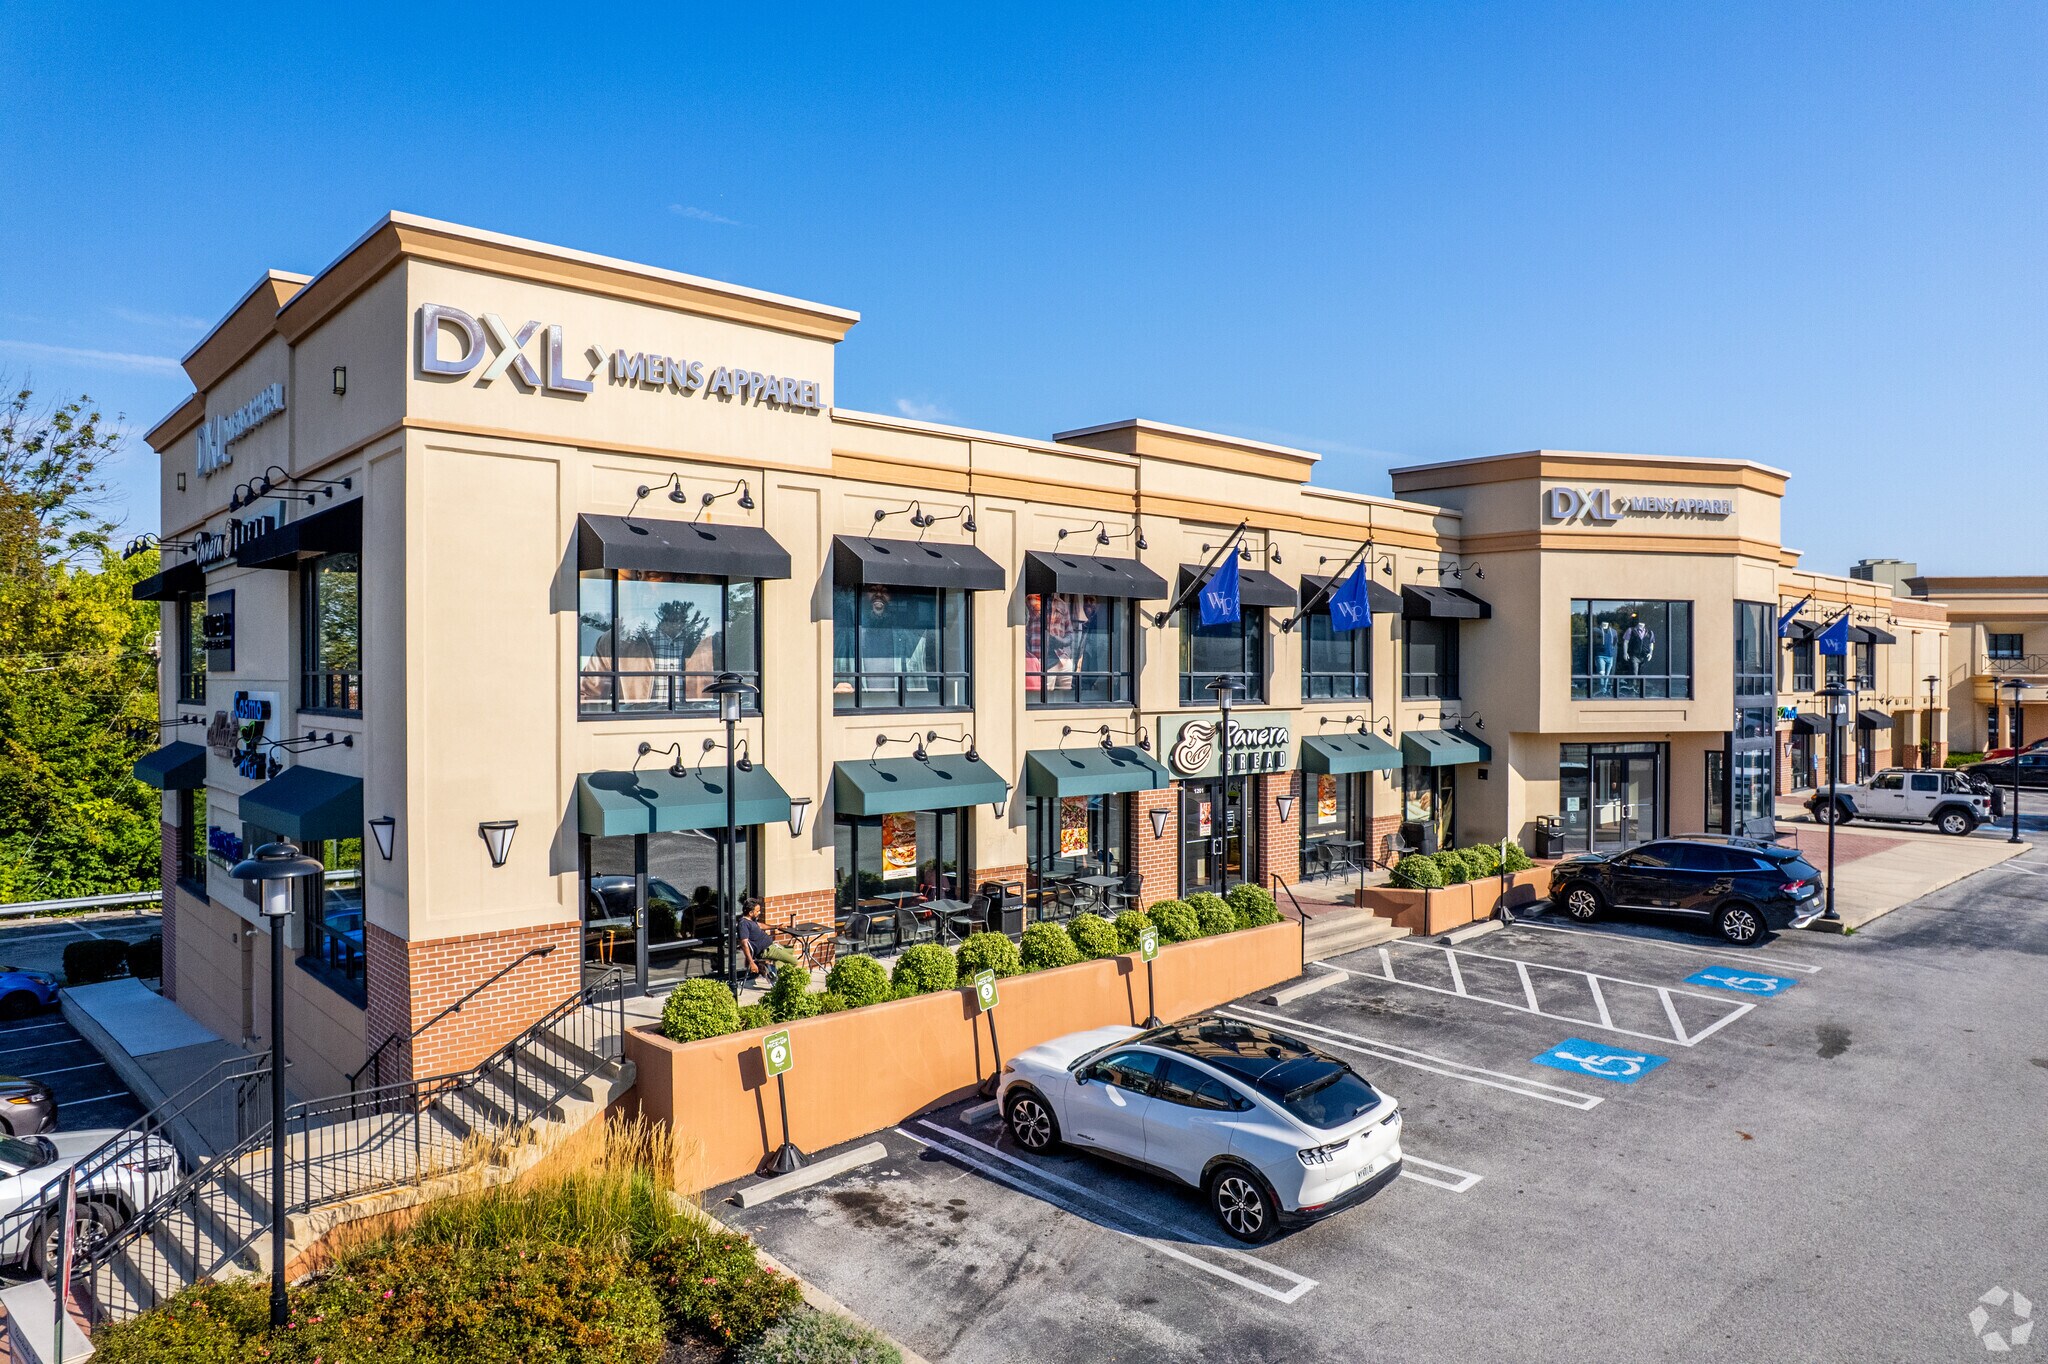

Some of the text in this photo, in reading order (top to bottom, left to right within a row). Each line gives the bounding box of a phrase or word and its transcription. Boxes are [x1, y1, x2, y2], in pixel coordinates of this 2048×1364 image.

[421, 303, 828, 409] DXL MENS APPAREL
[1551, 487, 1736, 520] DXL MENS APPAREL
[234, 691, 263, 720] Cosmo
[1221, 719, 1288, 747] Panera
[1226, 751, 1286, 771] BREAD
[776, 1050, 781, 1058] 4
